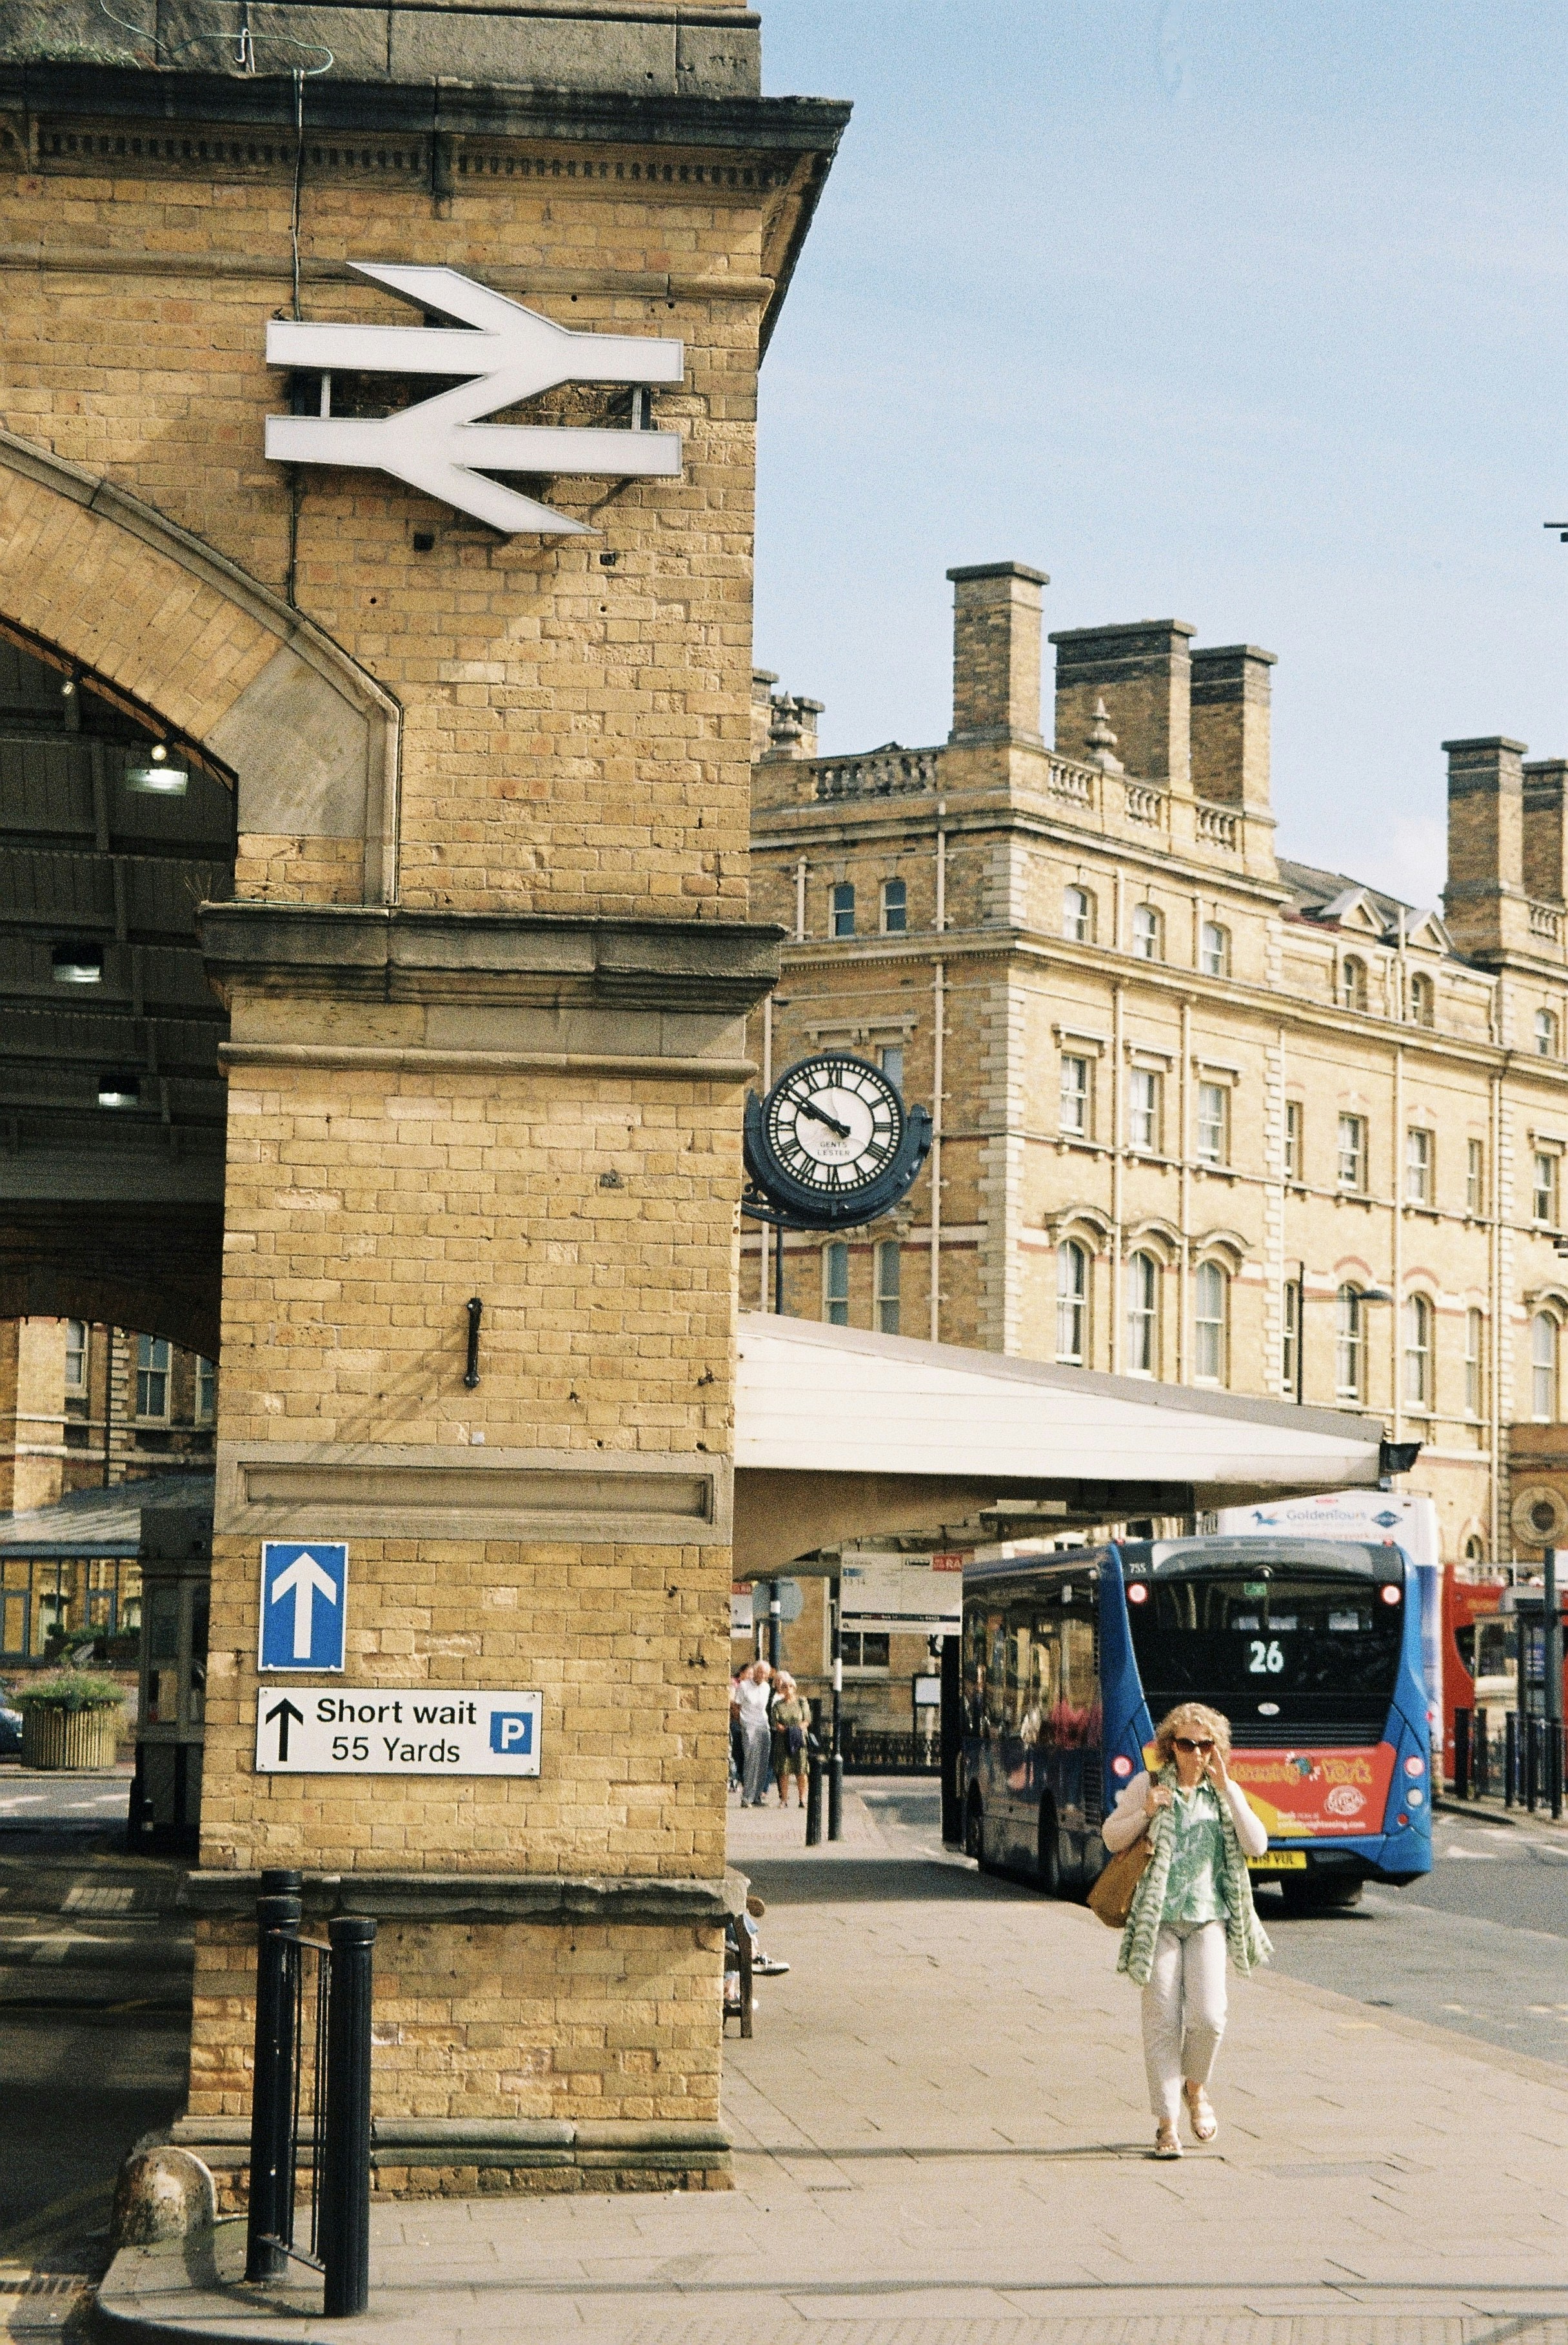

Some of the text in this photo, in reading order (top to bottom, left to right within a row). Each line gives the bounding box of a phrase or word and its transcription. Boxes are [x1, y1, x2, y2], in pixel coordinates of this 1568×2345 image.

[1249, 1641, 1284, 1673] 26
[316, 1698, 477, 1725] Short wait
[501, 1717, 526, 1749] P
[332, 1736, 461, 1762] 55 Yards
